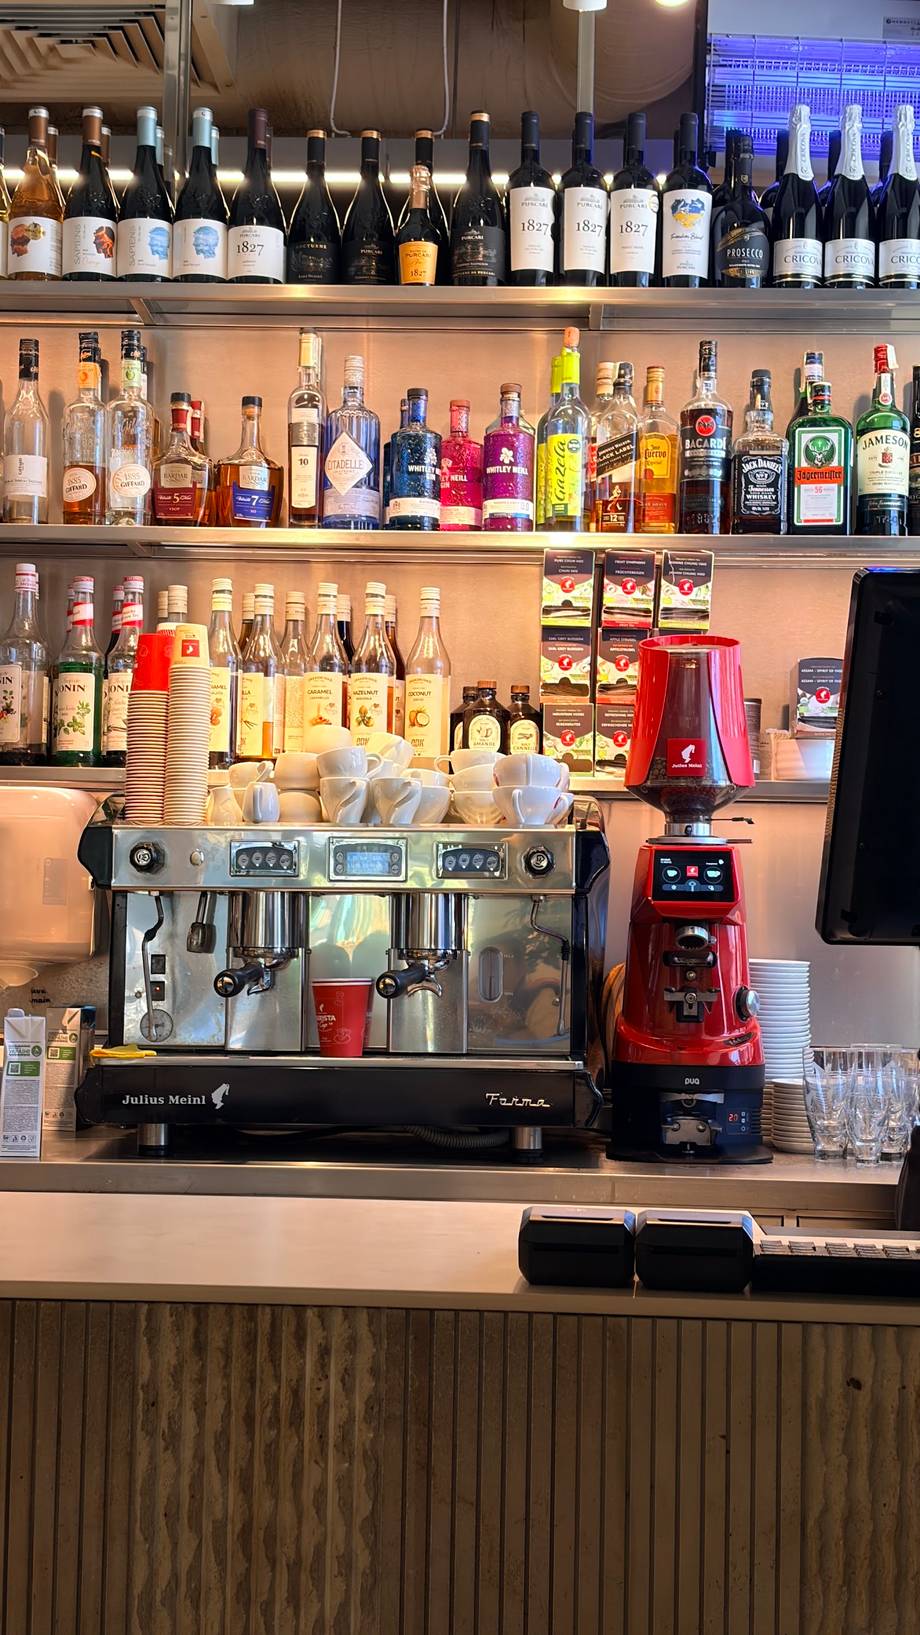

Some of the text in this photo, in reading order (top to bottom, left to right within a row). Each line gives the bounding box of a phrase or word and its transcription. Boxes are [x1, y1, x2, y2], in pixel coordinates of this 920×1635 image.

[521, 219, 549, 235] 1827
[576, 219, 603, 238] 1827
[619, 220, 648, 237] 1827
[237, 240, 264, 256] 1827
[726, 248, 764, 258] PROSECCO
[862, 434, 908, 450] JAMESON
[645, 449, 666, 460] Cuervo
[300, 458, 308, 466] 10
[742, 460, 758, 473] JACK
[408, 465, 436, 473] WHITLEY
[486, 466, 511, 474] WHITLEY
[554, 440, 566, 502] Gazela
[450, 474, 468, 482] NEILL
[172, 492, 180, 504] 5
[251, 496, 259, 506] 7
[610, 514, 618, 522] 12
[60, 684, 86, 692] ONIN
[122, 1094, 206, 1104] Julius Meinl
